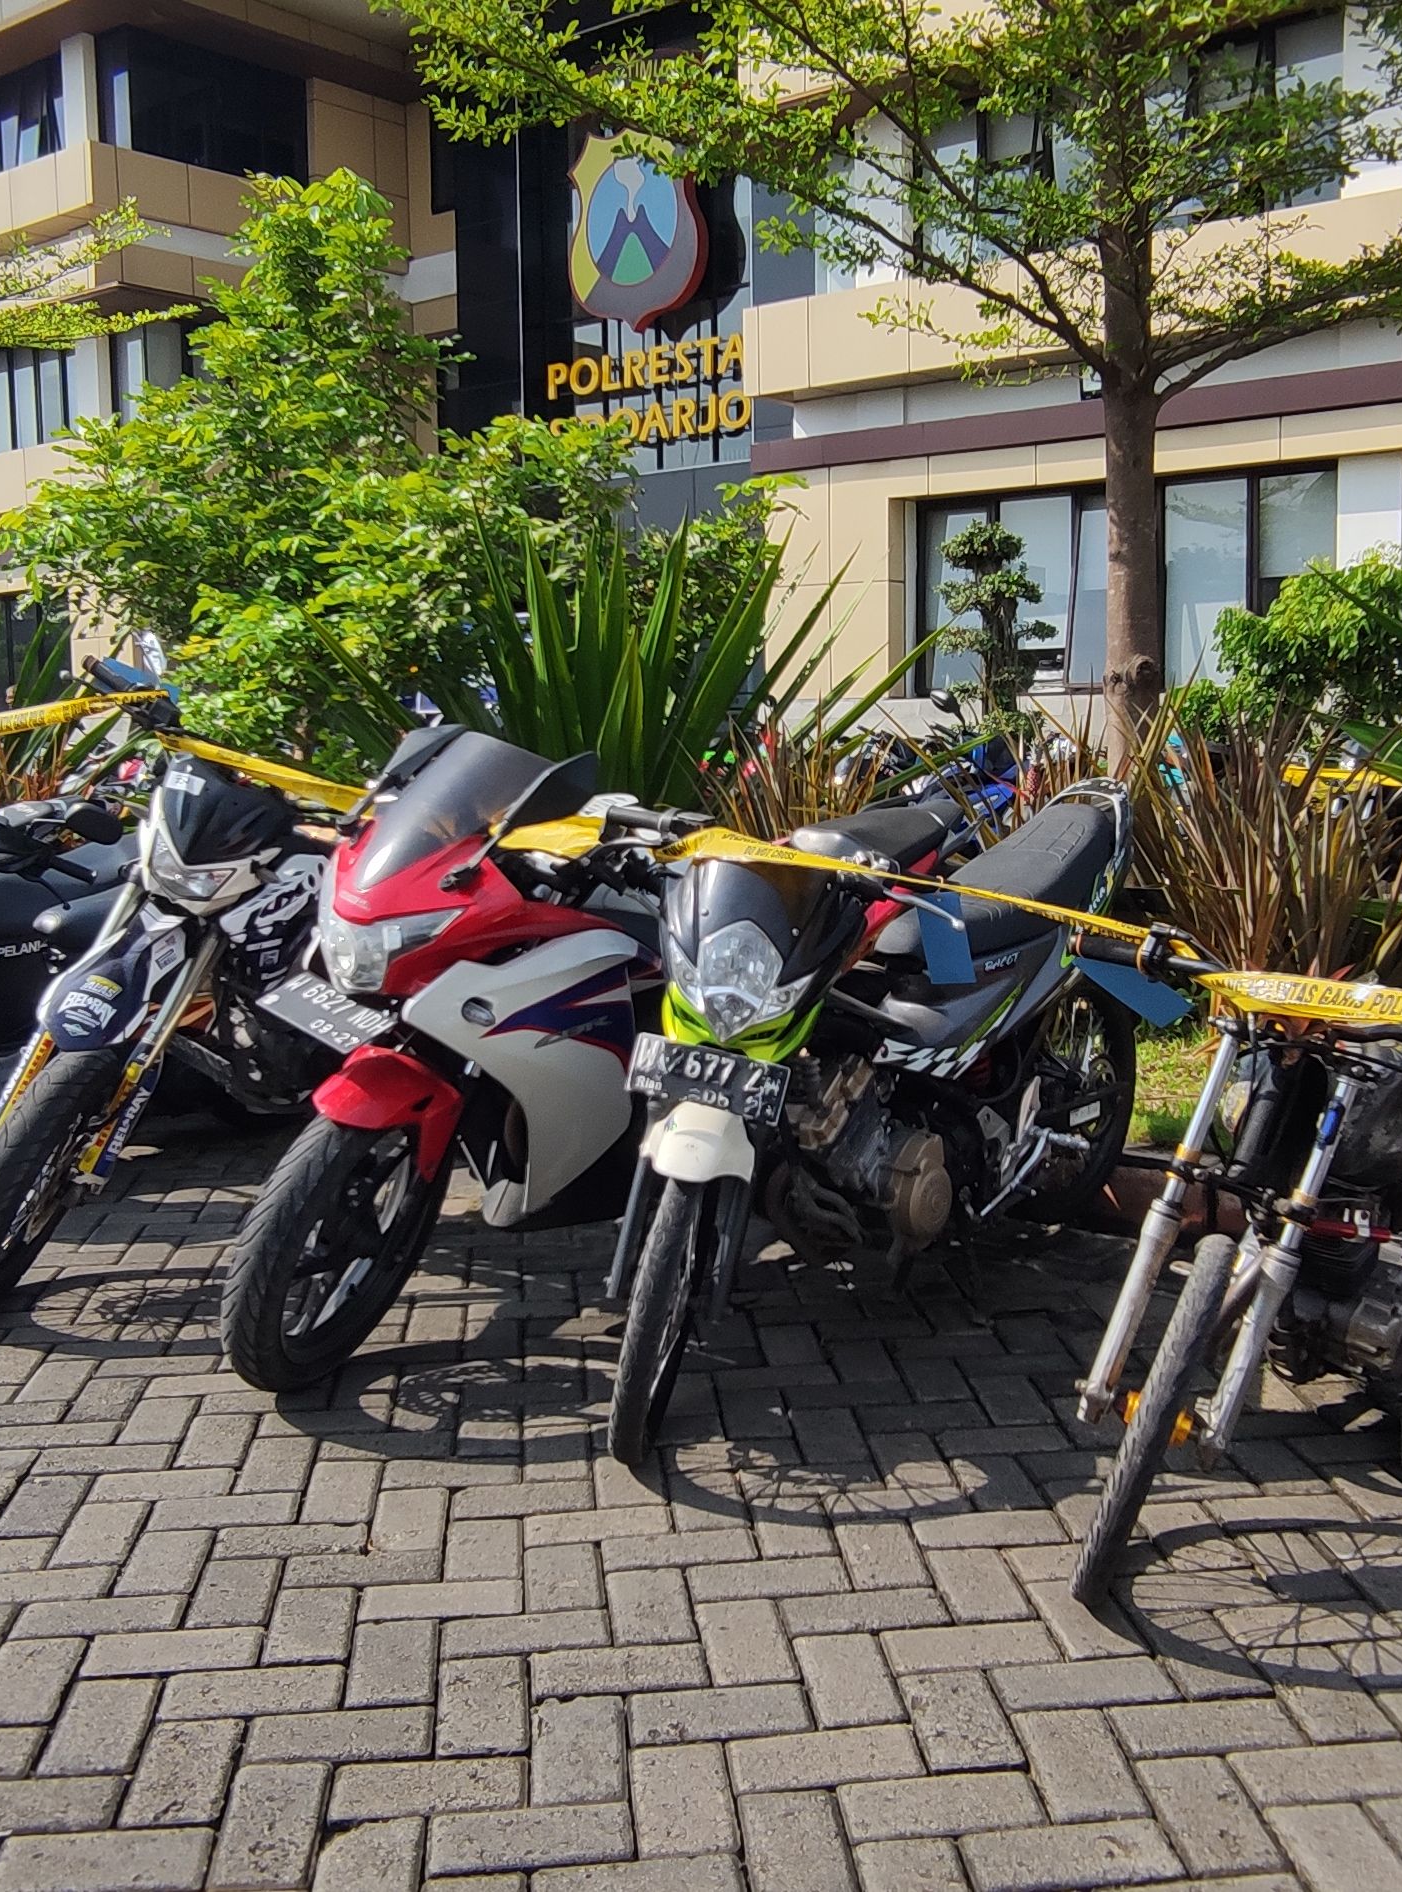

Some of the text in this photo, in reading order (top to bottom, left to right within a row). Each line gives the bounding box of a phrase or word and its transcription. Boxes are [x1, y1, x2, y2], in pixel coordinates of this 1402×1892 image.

[548, 332, 744, 400] POLRESTA
[549, 389, 751, 444] SOARJO
[302, 984, 357, 1015] 6627
[347, 1008, 395, 1038] NDH
